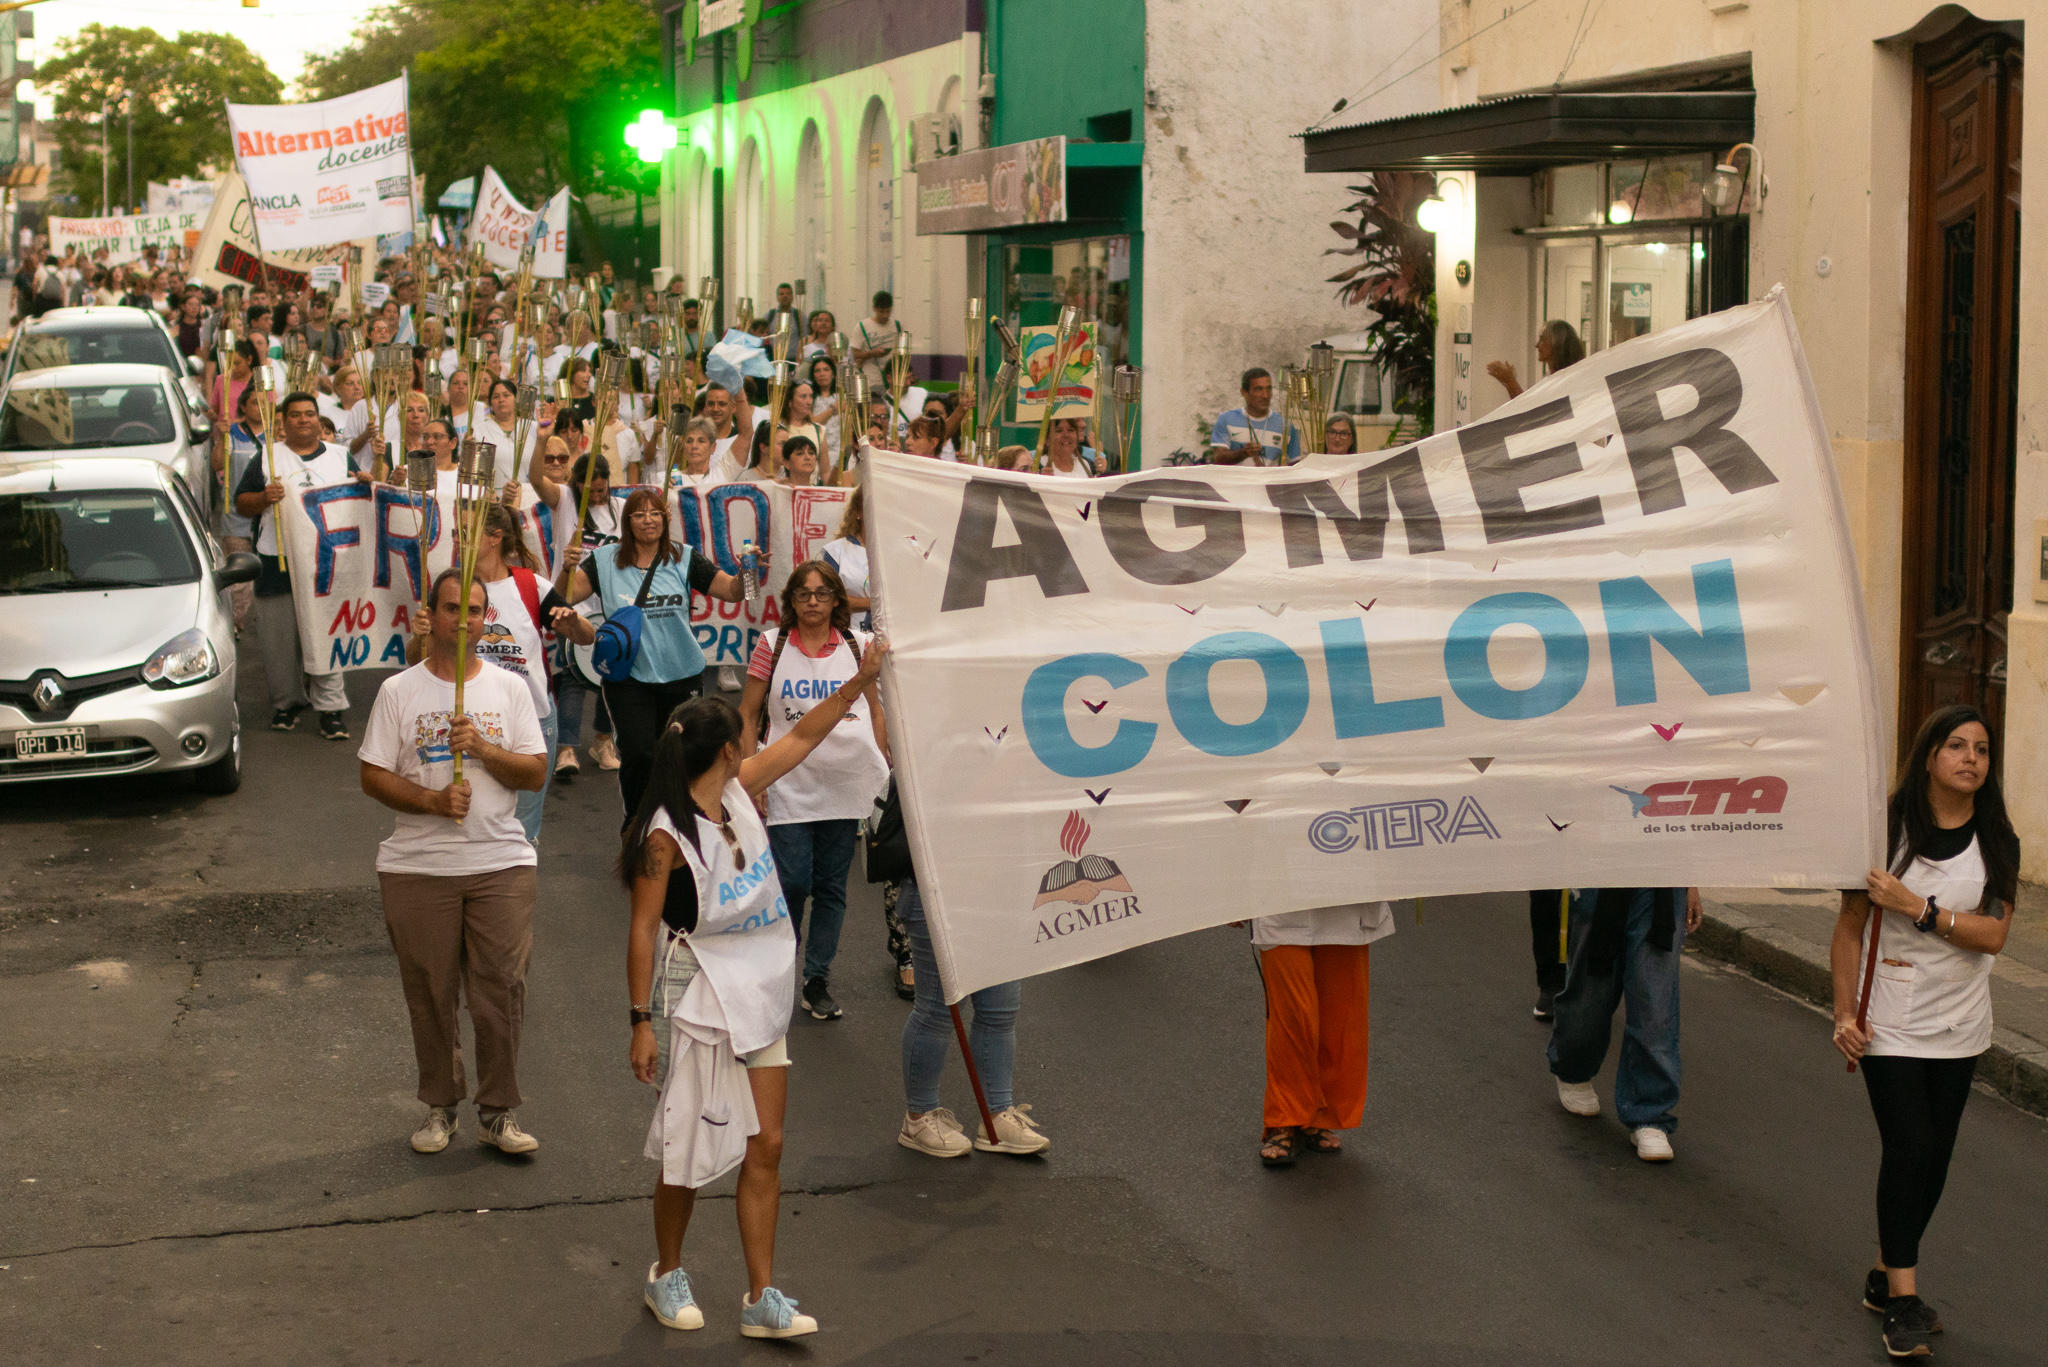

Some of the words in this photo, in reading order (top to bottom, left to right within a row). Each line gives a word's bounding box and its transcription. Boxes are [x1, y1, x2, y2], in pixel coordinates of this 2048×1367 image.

[237, 111, 406, 157] Alternativa
[318, 135, 407, 170] docente
[252, 194, 302, 210] ANCLA
[135, 215, 171, 234] DEJA
[179, 213, 196, 229] DE
[1455, 353, 1470, 379] Mer
[940, 347, 1781, 613] AGMER
[328, 597, 376, 635] NO
[330, 634, 371, 670] NO
[475, 645, 523, 655] GMER
[1021, 558, 1751, 778] COLON
[781, 679, 849, 699] AGME
[19, 738, 46, 754] OPH
[55, 735, 82, 752] 114
[1640, 776, 1788, 817] CTA
[1308, 796, 1501, 854] CTERA
[1643, 824, 1661, 834] de
[1665, 823, 1686, 832] los
[1691, 821, 1783, 833] trabajadores
[719, 844, 775, 906] AGME
[722, 896, 788, 932] COLO
[1034, 895, 1142, 944] AGMER
